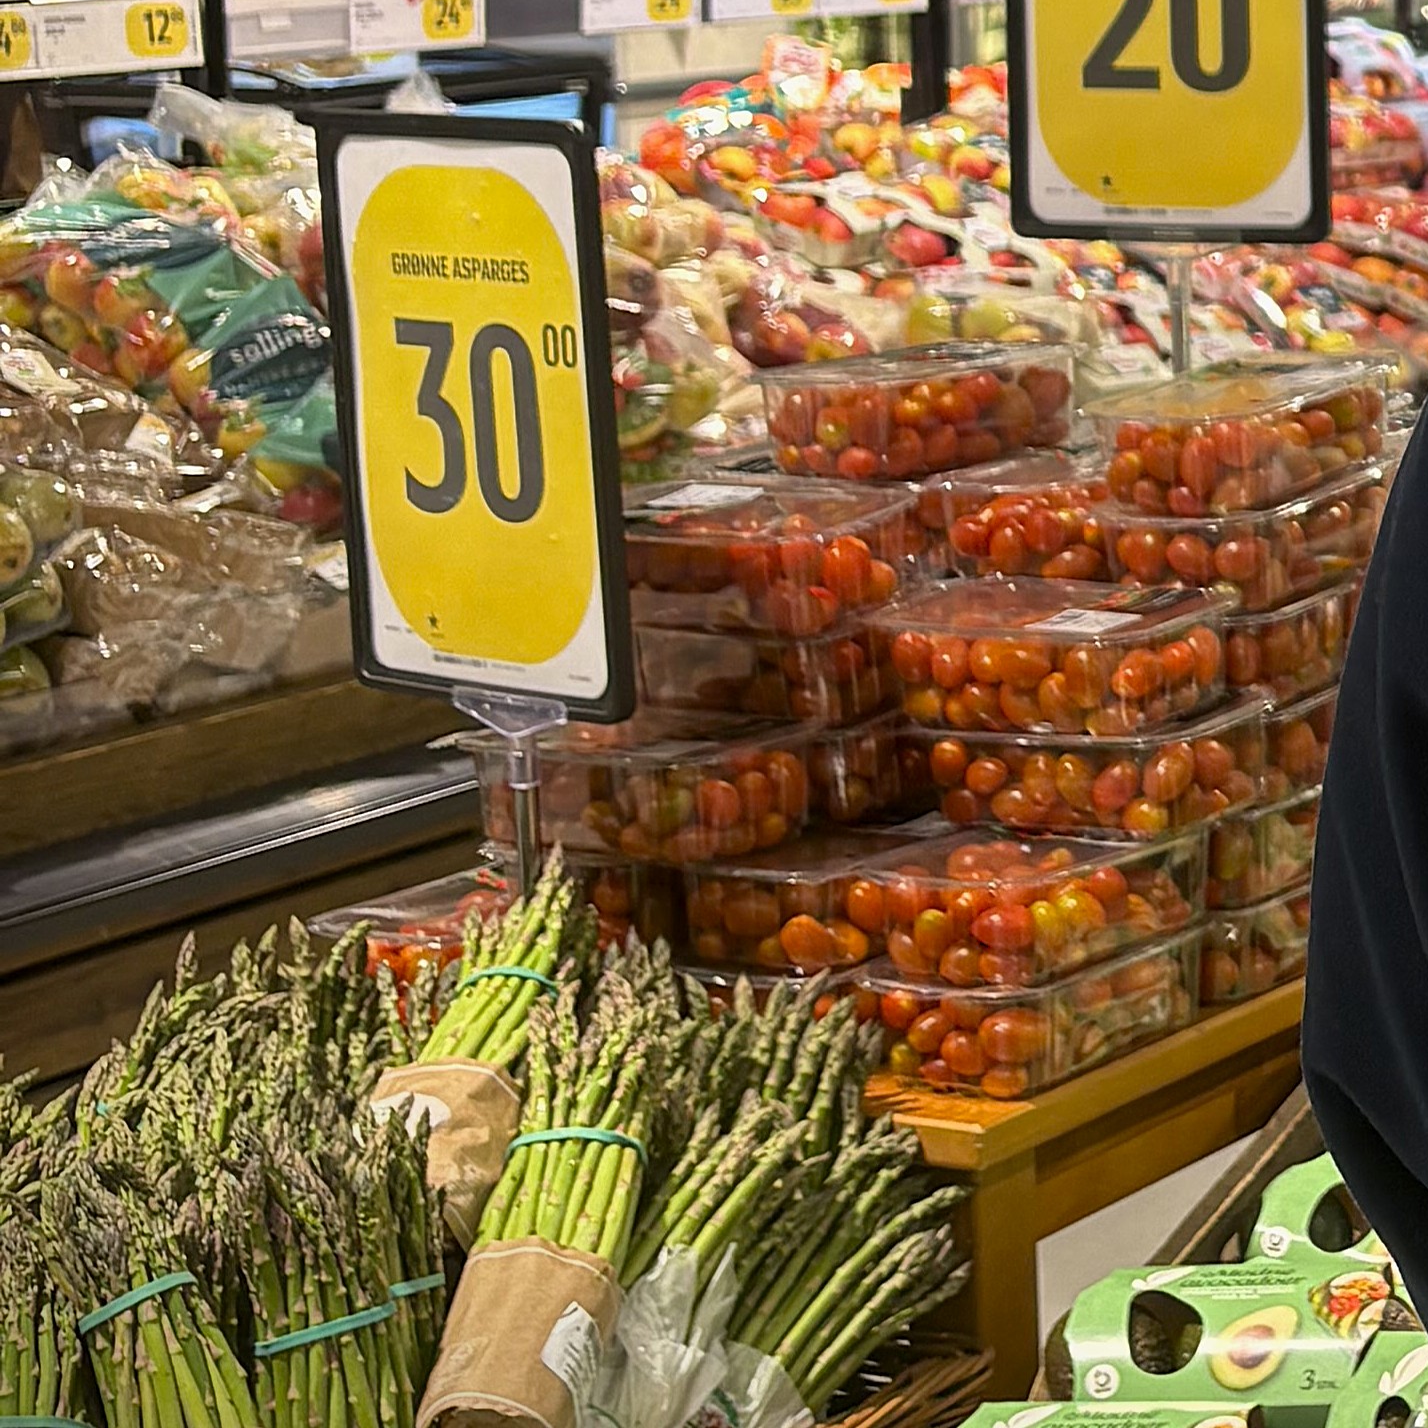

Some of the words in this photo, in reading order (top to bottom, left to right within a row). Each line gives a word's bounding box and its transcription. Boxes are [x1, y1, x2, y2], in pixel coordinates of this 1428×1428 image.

[143, 9, 171, 47] 12
[391, 251, 449, 277] GRØNNE
[452, 255, 530, 285] ASPARGES
[229, 323, 323, 367] salling
[393, 316, 545, 523] 30
[541, 322, 579, 369] 00
